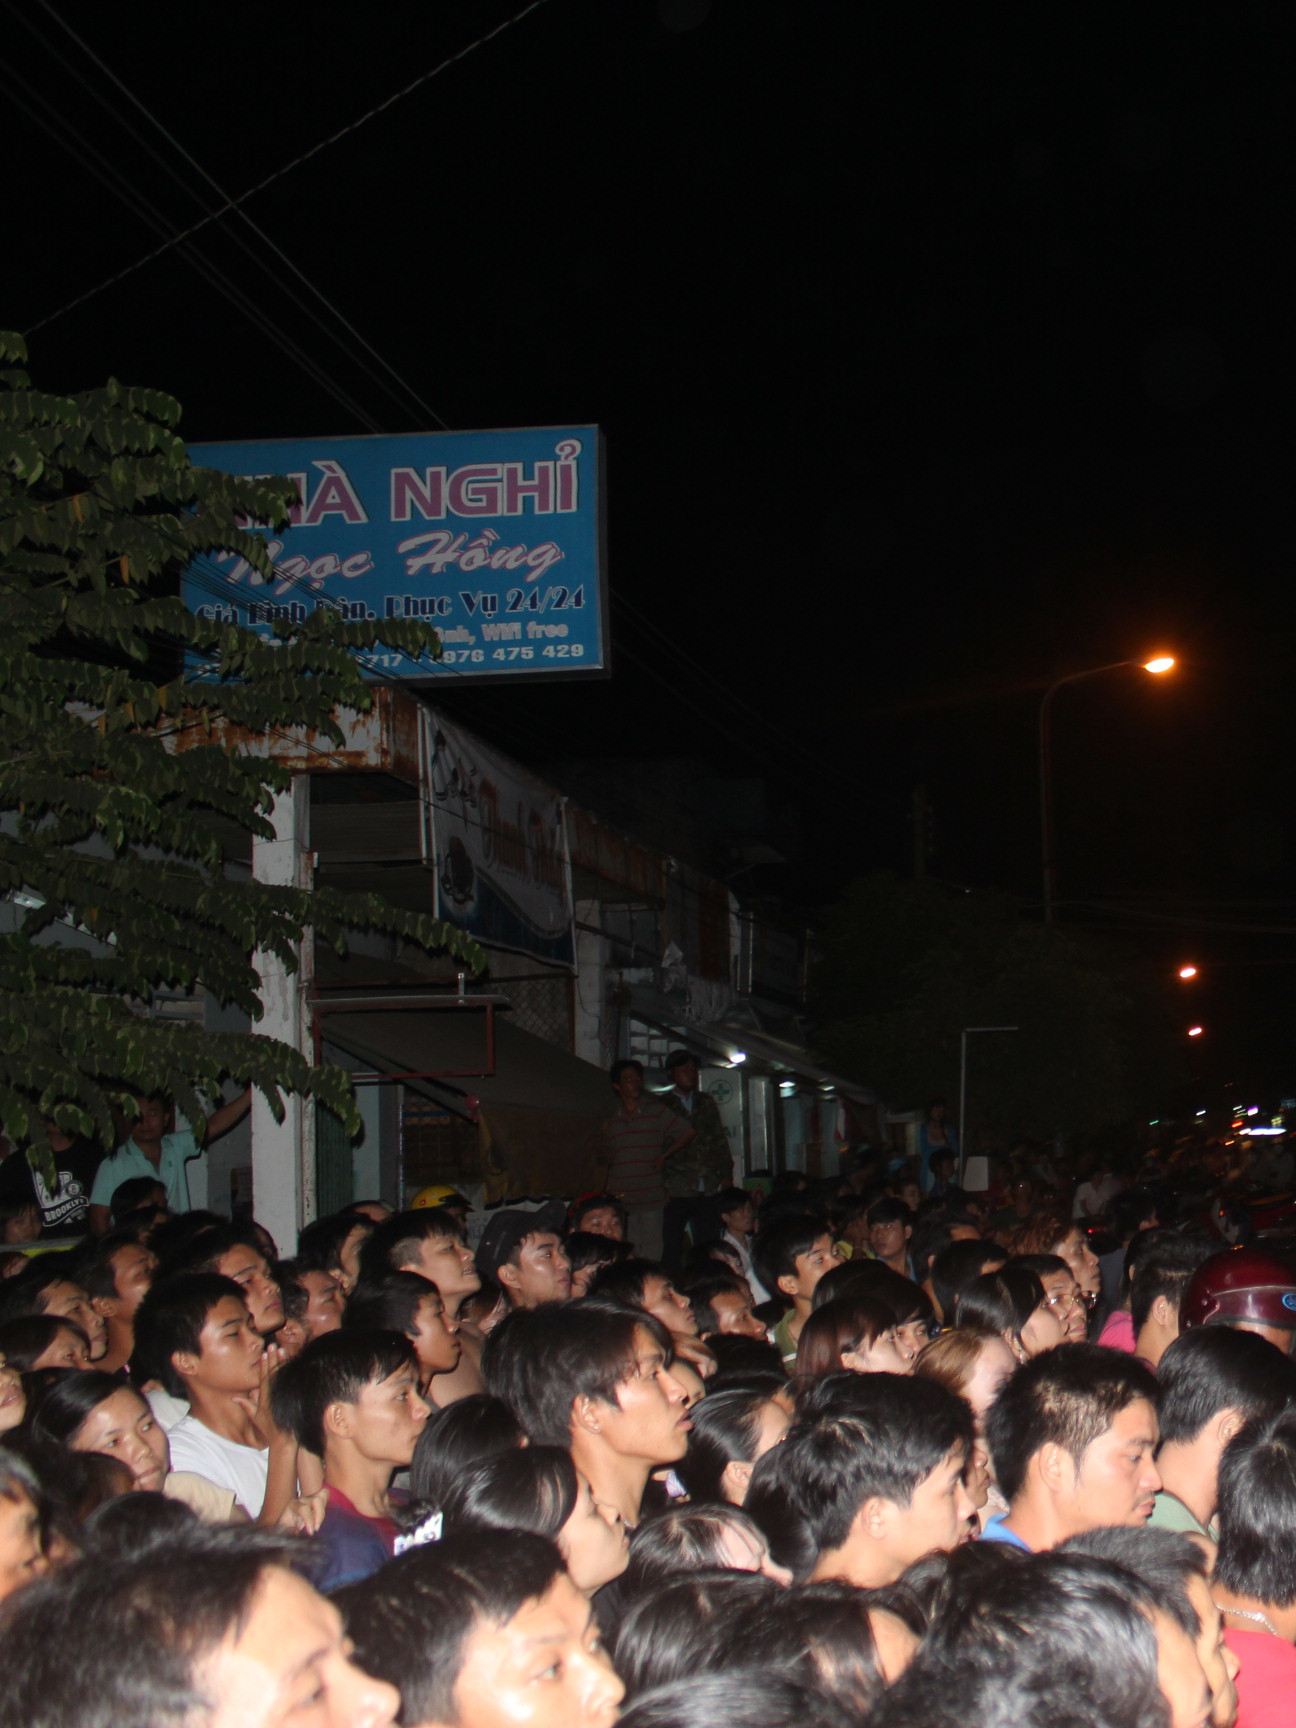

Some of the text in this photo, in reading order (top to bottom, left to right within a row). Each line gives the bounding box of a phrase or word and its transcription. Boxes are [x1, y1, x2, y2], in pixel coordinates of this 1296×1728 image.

[390, 438, 582, 521] NGHỈ
[397, 528, 565, 582] Hồng
[384, 595, 452, 622] Phục
[459, 591, 498, 619] Vụ
[505, 584, 585, 614] 24/24
[526, 621, 569, 639] free
[492, 646, 534, 661] 475
[541, 643, 585, 658] 429
